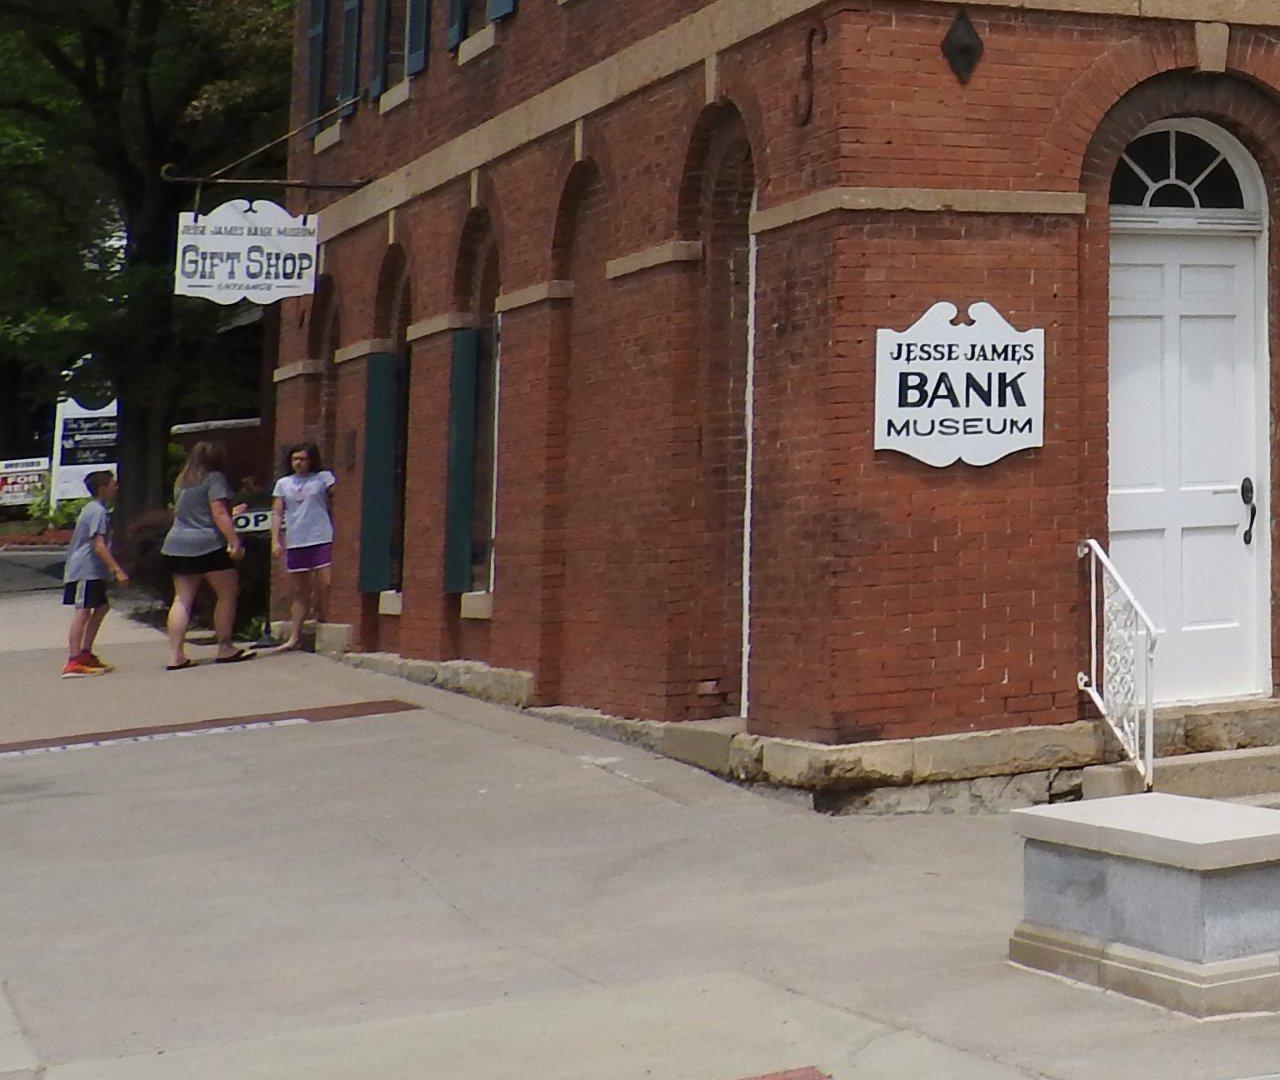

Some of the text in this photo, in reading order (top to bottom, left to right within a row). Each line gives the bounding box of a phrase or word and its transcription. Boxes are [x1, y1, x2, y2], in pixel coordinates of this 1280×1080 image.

[181, 225, 315, 237] JESSE JAMES BANK MUSEUM
[181, 244, 313, 280] GIFT SHOP
[889, 343, 1035, 365] JESSE JAMES
[898, 372, 1027, 408] BANK
[887, 417, 1033, 437] MUSEUM
[7, 474, 40, 485] FOR
